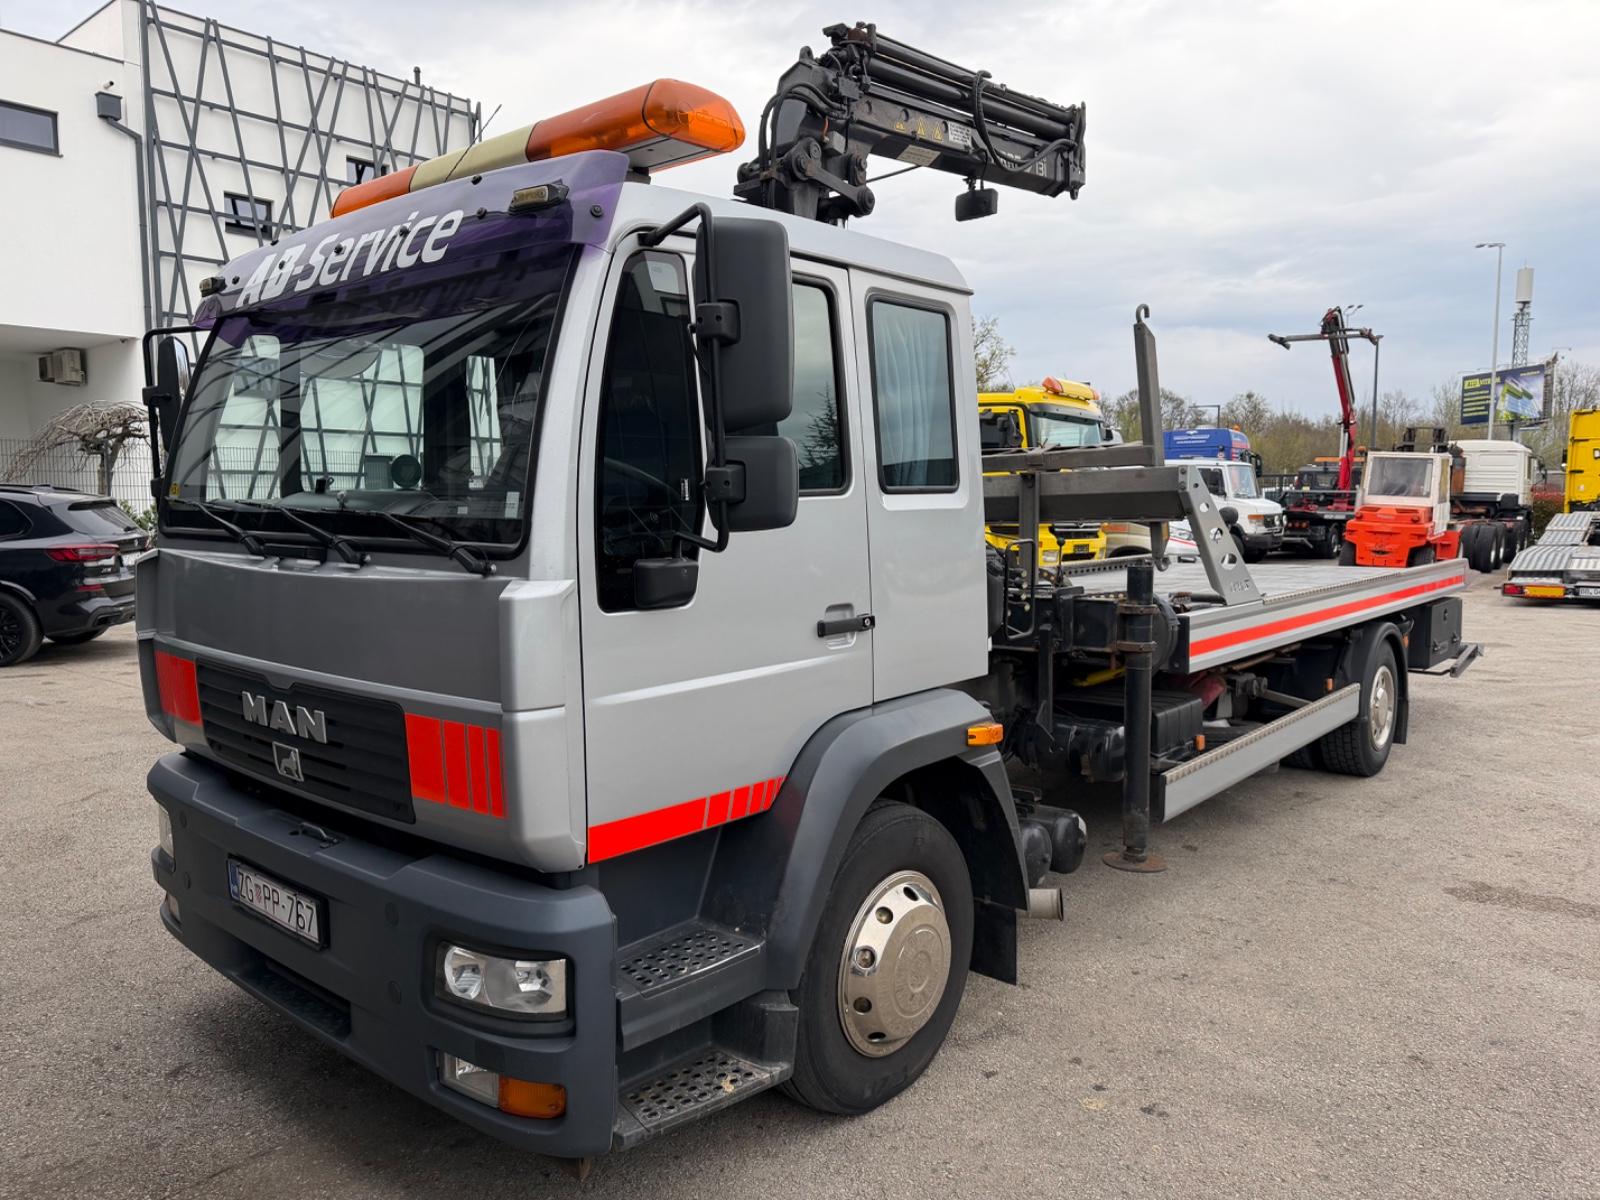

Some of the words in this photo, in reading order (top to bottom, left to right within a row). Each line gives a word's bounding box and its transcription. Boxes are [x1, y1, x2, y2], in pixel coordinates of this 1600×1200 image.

[235, 210, 464, 308] AB-Service
[242, 691, 327, 744] MAN
[238, 872, 254, 902] ZG
[262, 884, 314, 932] PP-767
